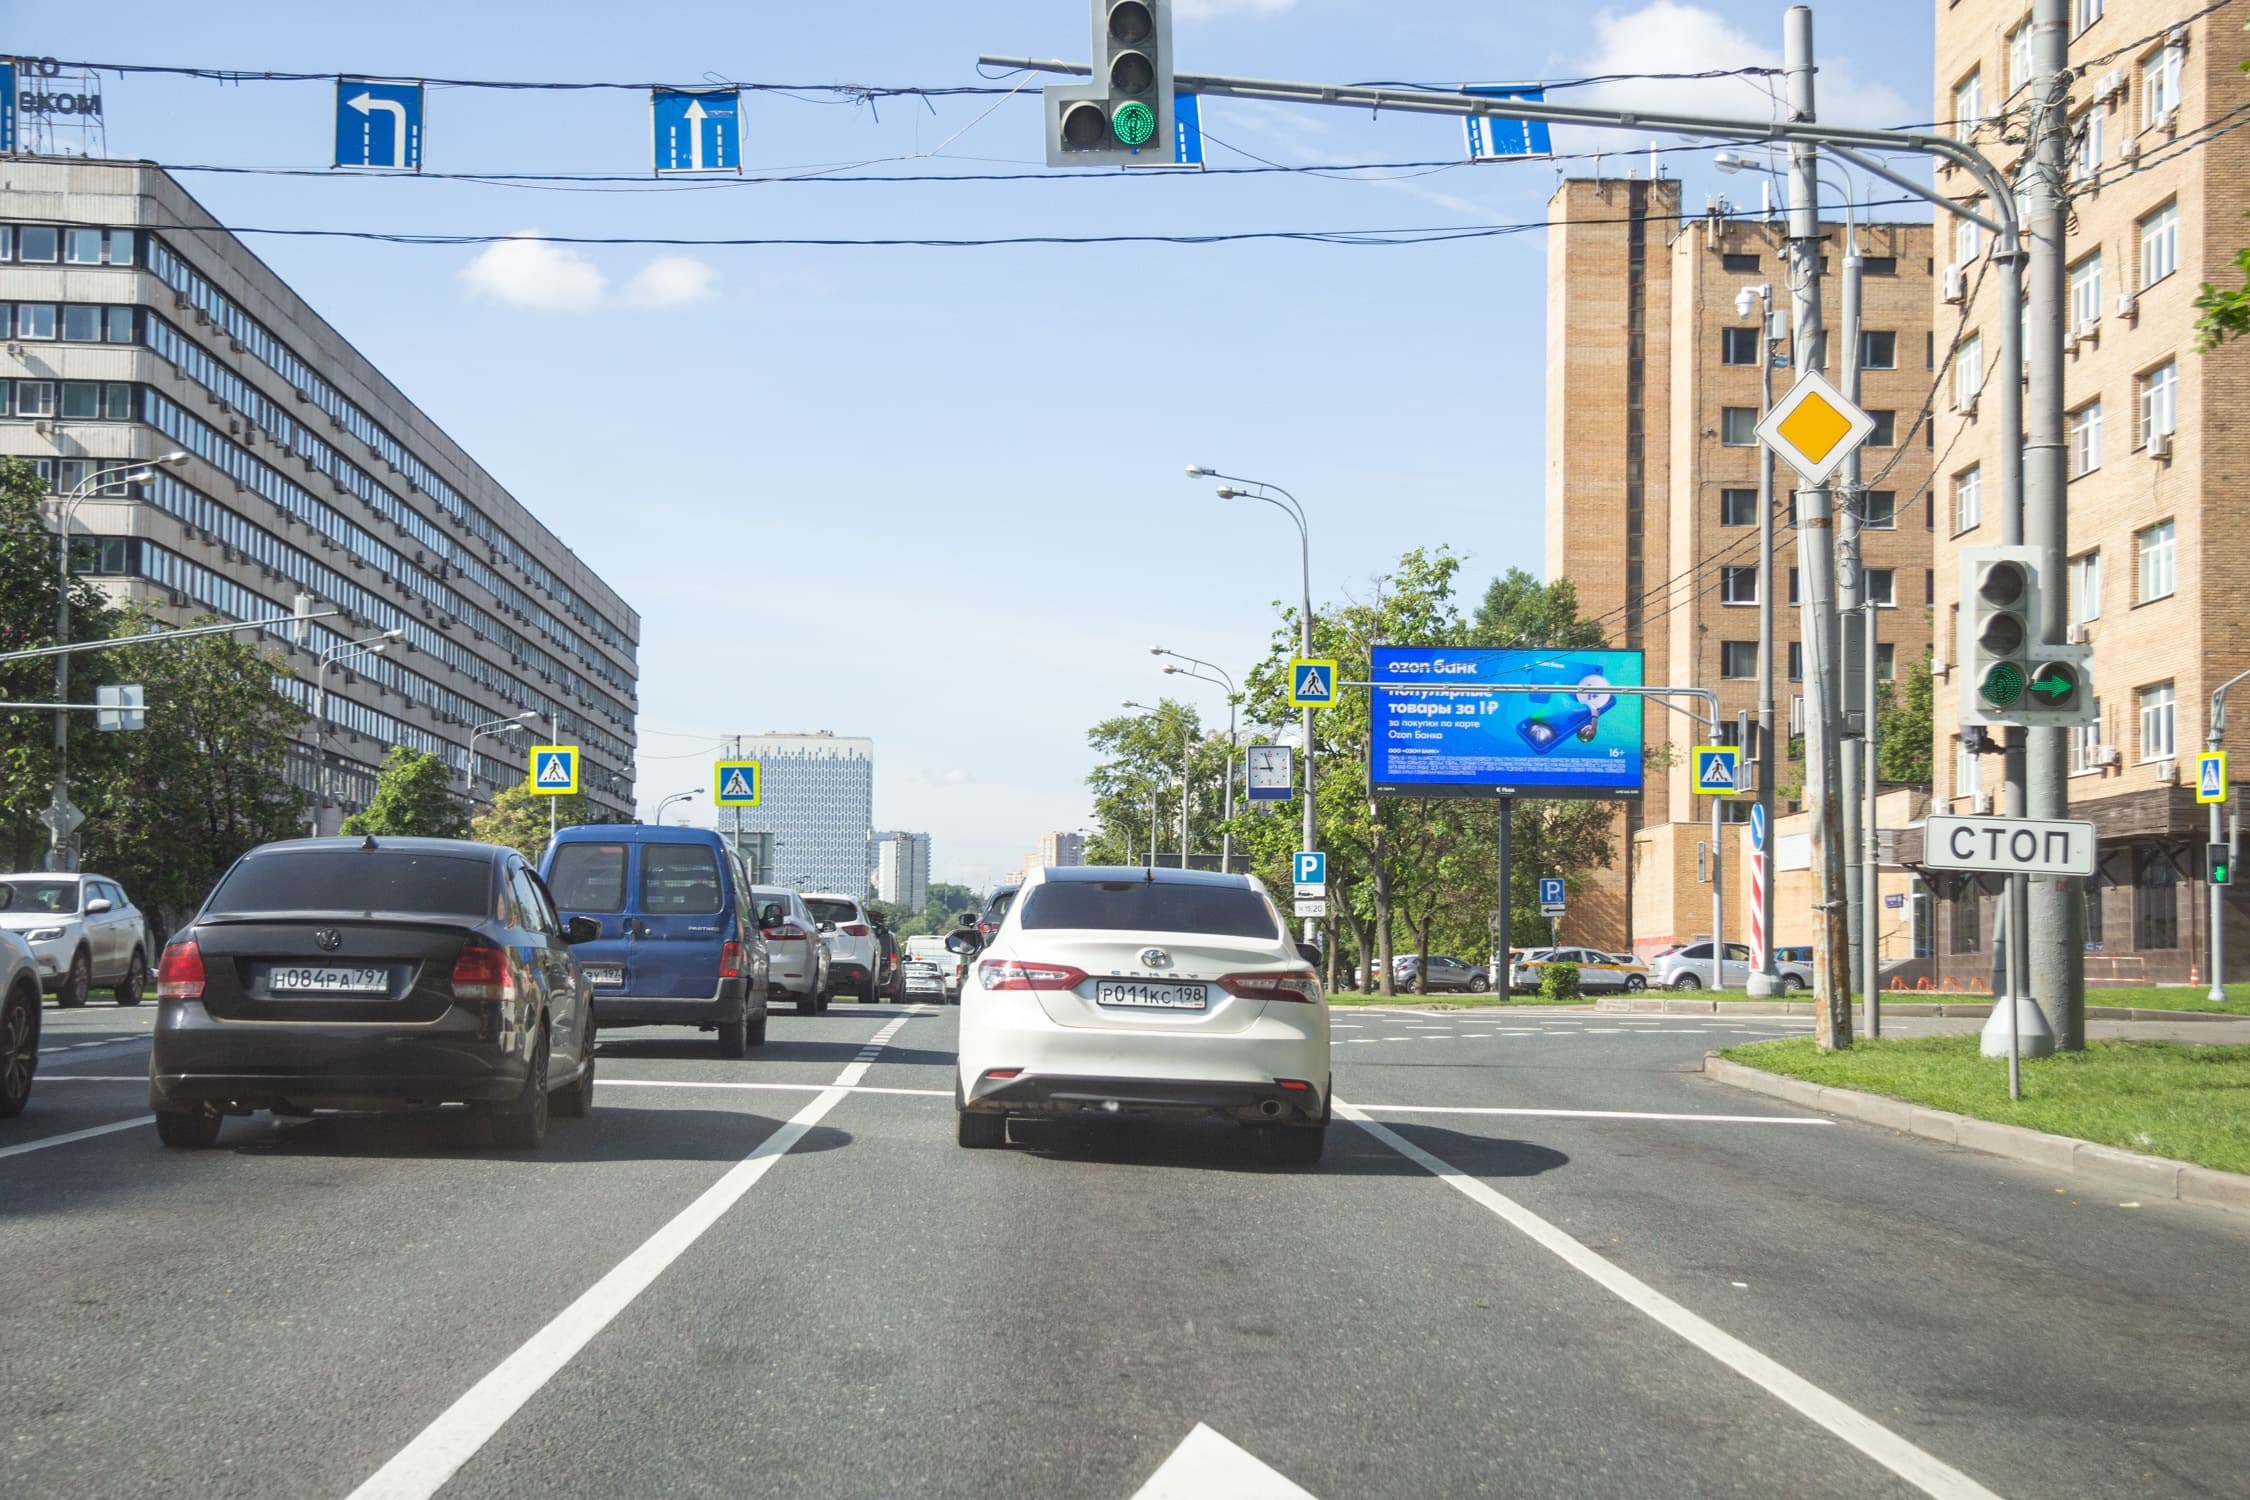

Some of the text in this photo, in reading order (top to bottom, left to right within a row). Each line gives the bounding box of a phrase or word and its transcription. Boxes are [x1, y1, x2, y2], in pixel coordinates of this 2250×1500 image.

[1388, 658, 1477, 674] ozon банк
[1388, 703, 1451, 717] товары
[1456, 704, 1475, 715] за
[1402, 720, 1438, 729] покупки
[1455, 720, 1480, 729] карте
[1388, 730, 1443, 740] Ozon Банка
[1609, 747, 1625, 758] 16+
[1950, 826, 2070, 864] СТОП
[1301, 855, 1318, 881] P
[1546, 881, 1561, 901] P
